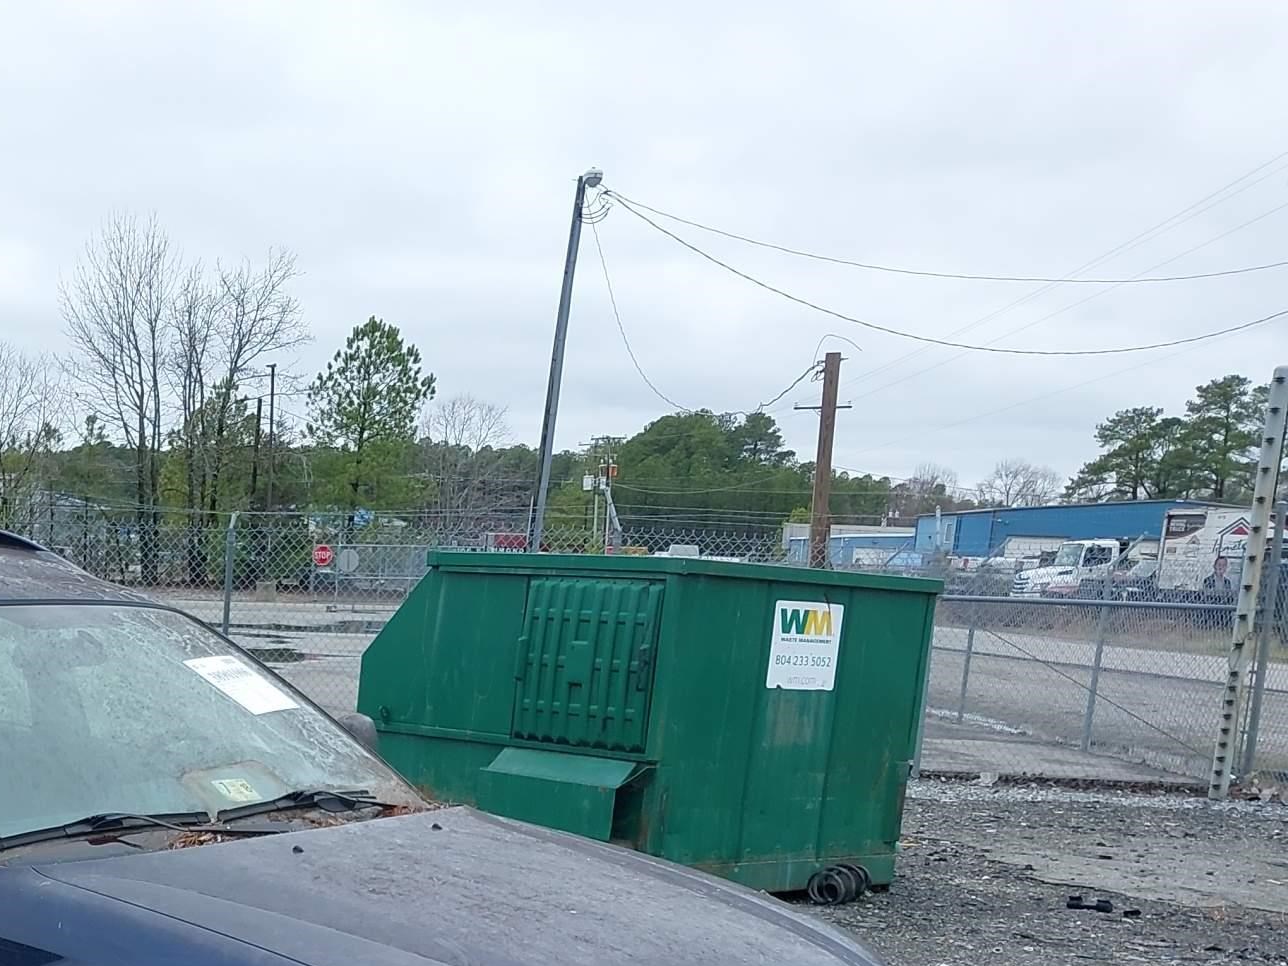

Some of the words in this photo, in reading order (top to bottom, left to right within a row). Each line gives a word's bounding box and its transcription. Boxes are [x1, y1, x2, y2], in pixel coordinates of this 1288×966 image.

[314, 551, 331, 559] STOP
[780, 608, 832, 637] WM
[775, 654, 792, 665] 804
[792, 655, 809, 666] 233
[810, 656, 832, 667] 5052
